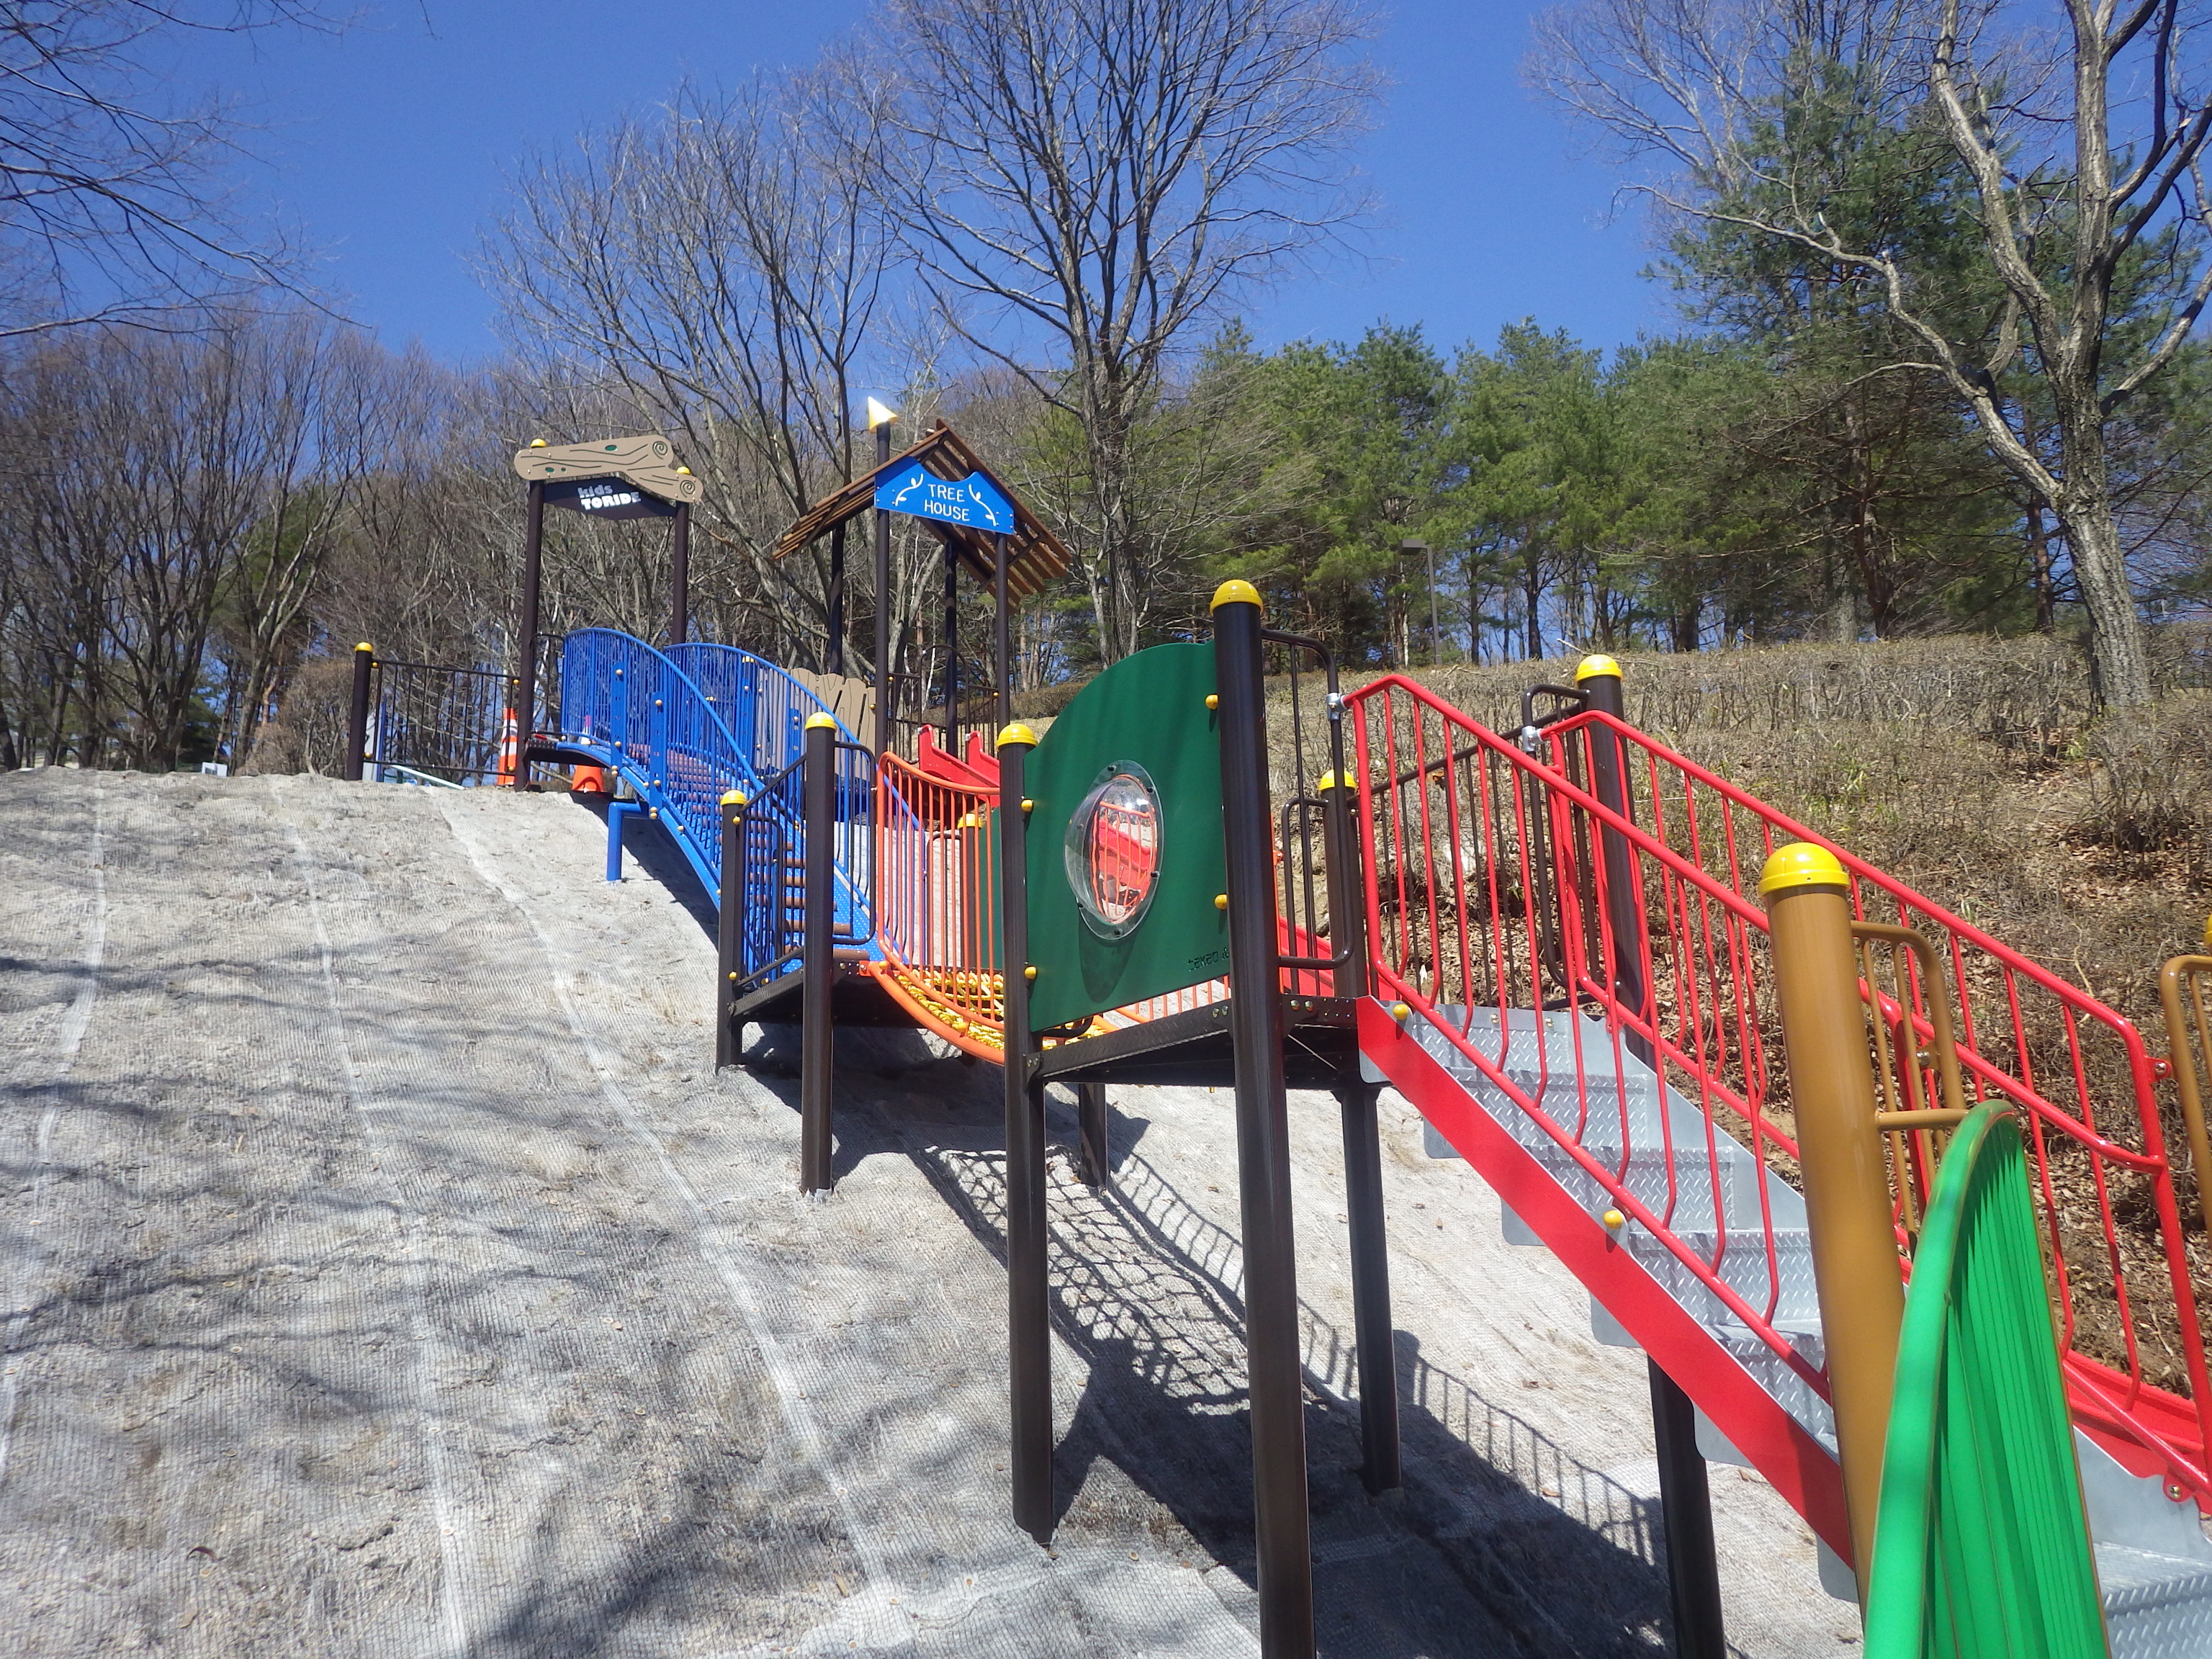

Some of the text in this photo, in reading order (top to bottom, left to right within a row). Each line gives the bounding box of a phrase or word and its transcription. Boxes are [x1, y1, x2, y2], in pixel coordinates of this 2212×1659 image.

[577, 484, 613, 498] kids
[927, 483, 965, 502] TREE
[581, 492, 641, 510] TORIDE
[924, 499, 969, 521] HOUSE
